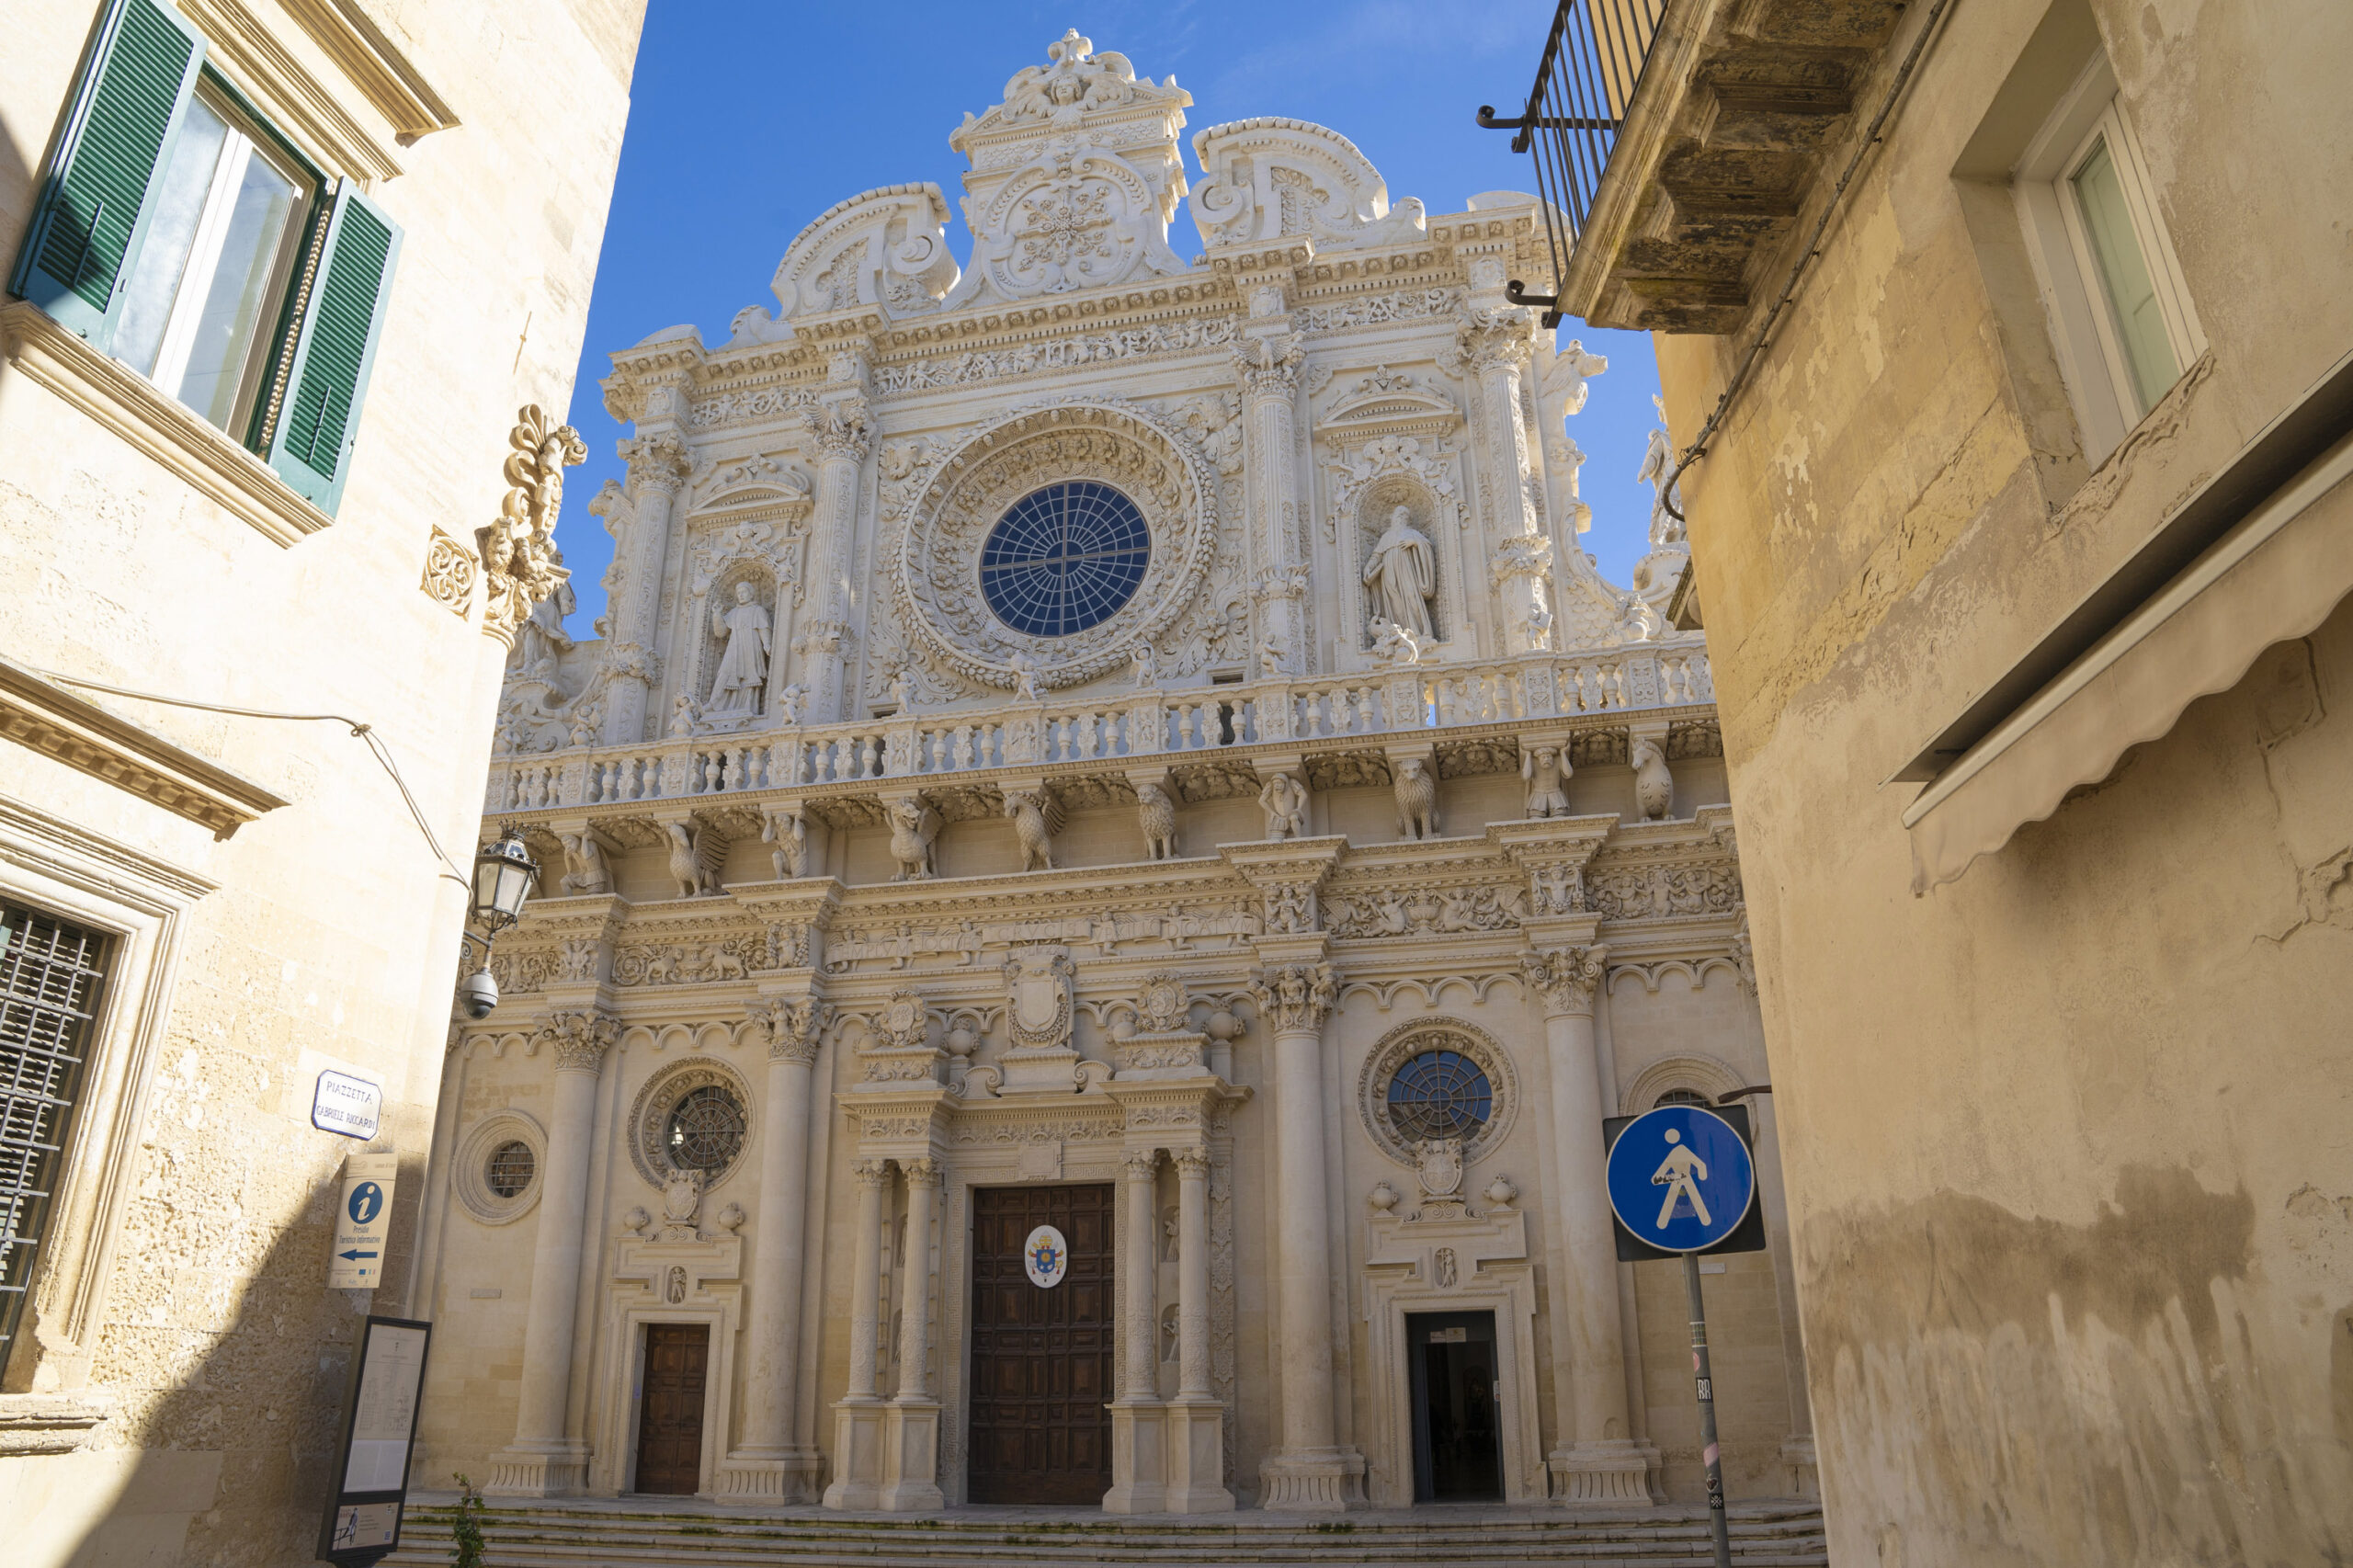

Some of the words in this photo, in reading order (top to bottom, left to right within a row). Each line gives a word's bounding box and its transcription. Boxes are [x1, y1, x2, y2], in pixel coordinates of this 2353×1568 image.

[998, 923, 1076, 942] CRVCIS
[326, 1080, 373, 1105] PIAZZETTA
[315, 1105, 345, 1122] GABRIELE
[346, 1112, 376, 1131] RICCARDI
